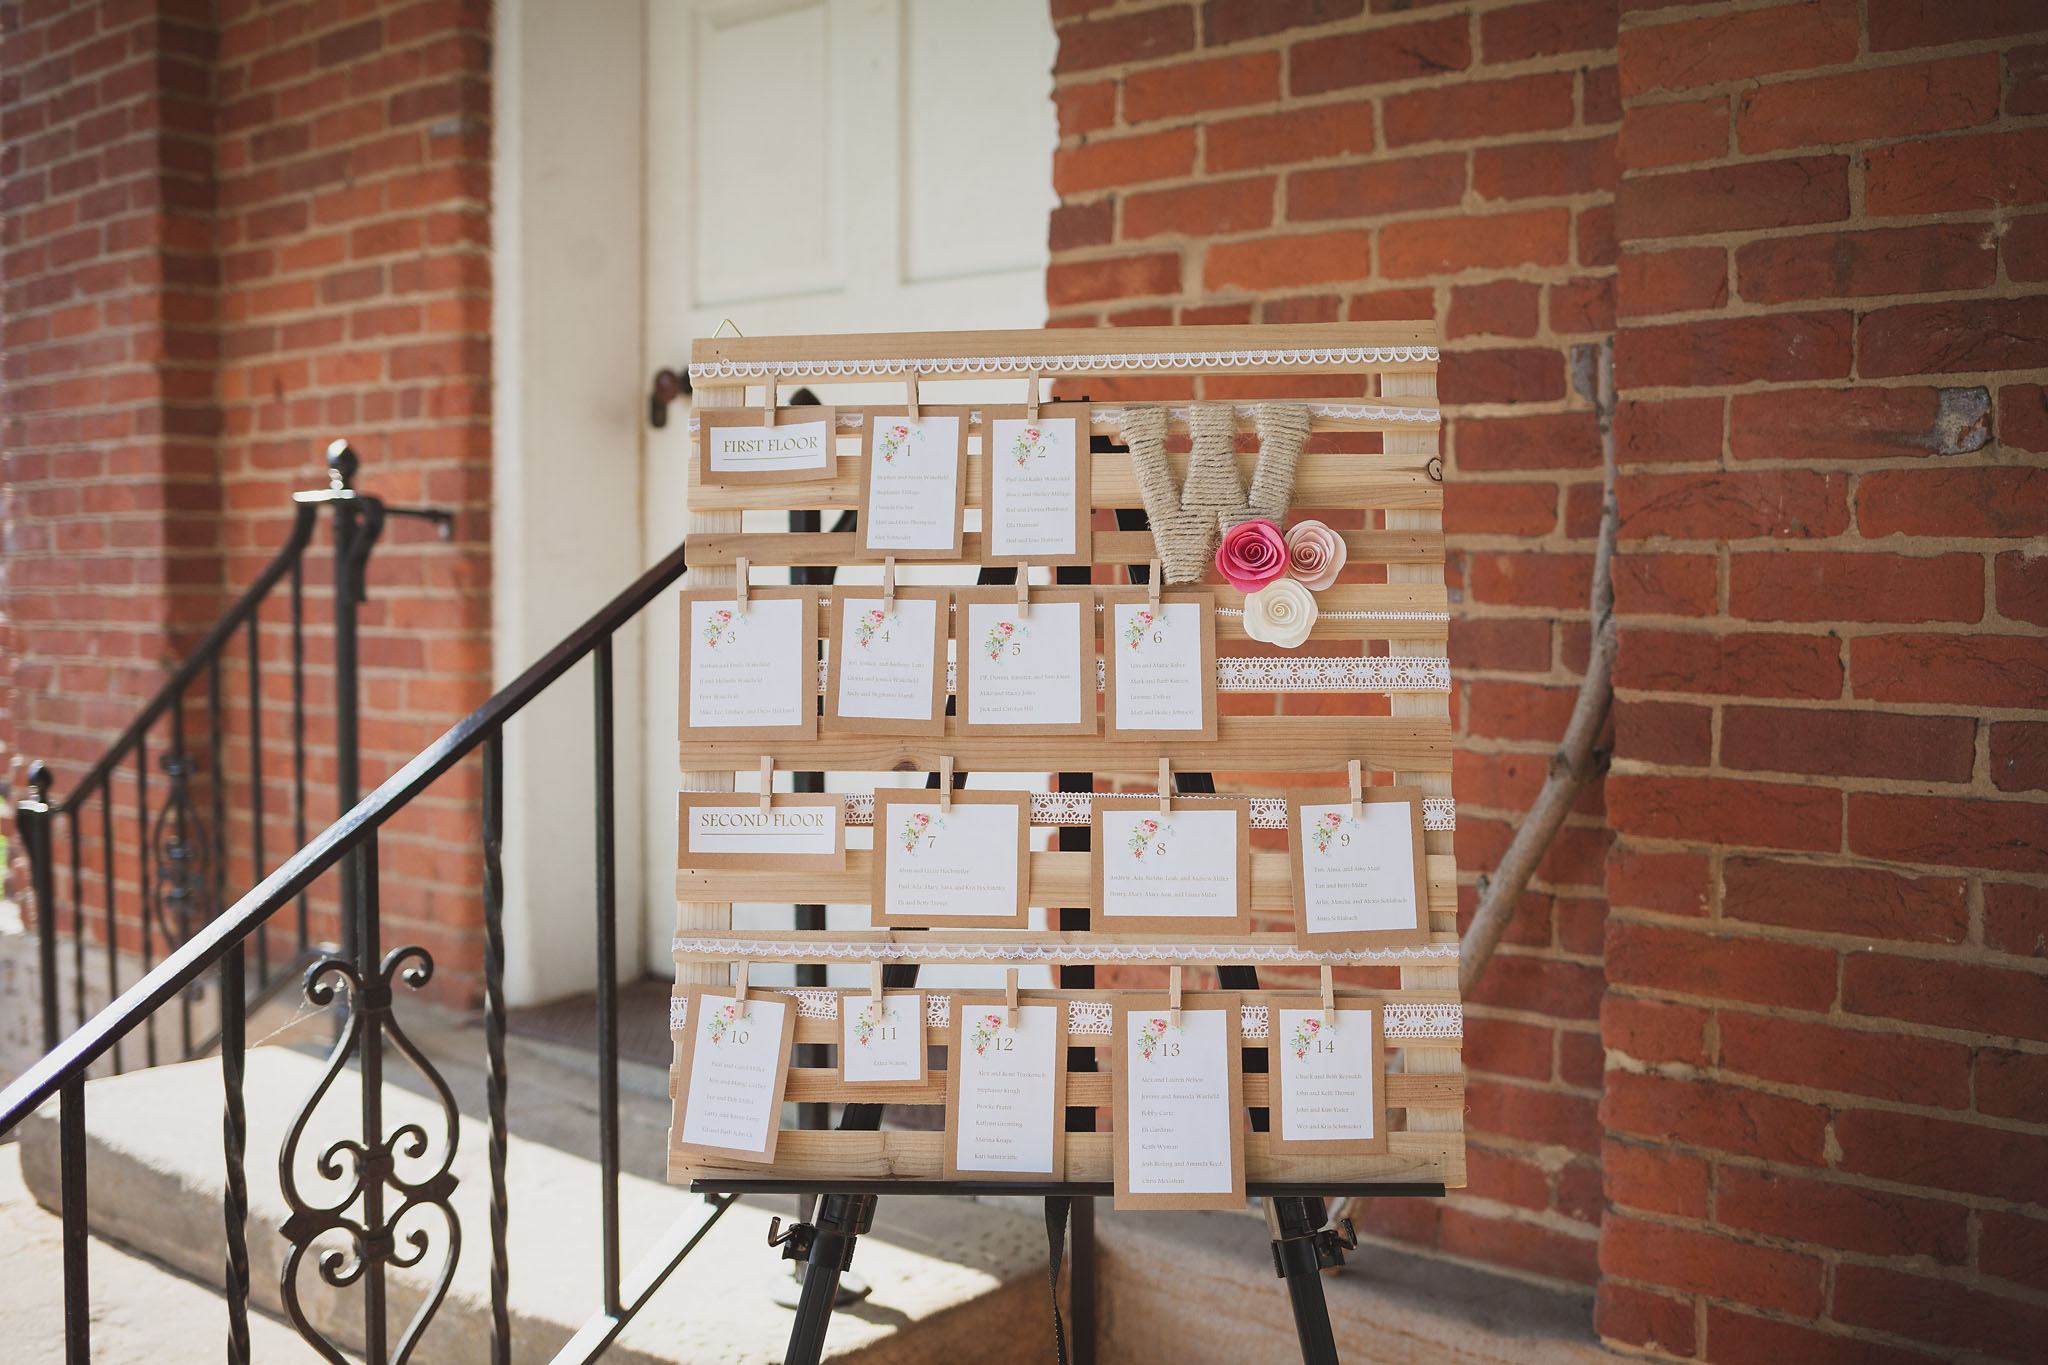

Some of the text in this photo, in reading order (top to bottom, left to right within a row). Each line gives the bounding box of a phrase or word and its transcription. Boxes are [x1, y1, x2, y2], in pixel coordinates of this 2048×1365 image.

[723, 436, 818, 453] FIRST FLOOR
[905, 445, 911, 457] 1
[1037, 445, 1046, 458] 2
[1120, 403, 1311, 585] W
[727, 631, 736, 644] 3
[881, 631, 891, 643] 4
[1153, 630, 1163, 644] 6
[1012, 643, 1021, 656] 5
[701, 813, 825, 827] SECOND FLOOR
[927, 835, 936, 848] 7
[1340, 833, 1351, 848] 9
[1156, 842, 1167, 856] 8
[730, 1030, 750, 1045] 10
[881, 1026, 898, 1041] 11
[994, 1037, 1014, 1051] 12
[1161, 1043, 1181, 1057] 13
[1316, 1039, 1335, 1054] 14
